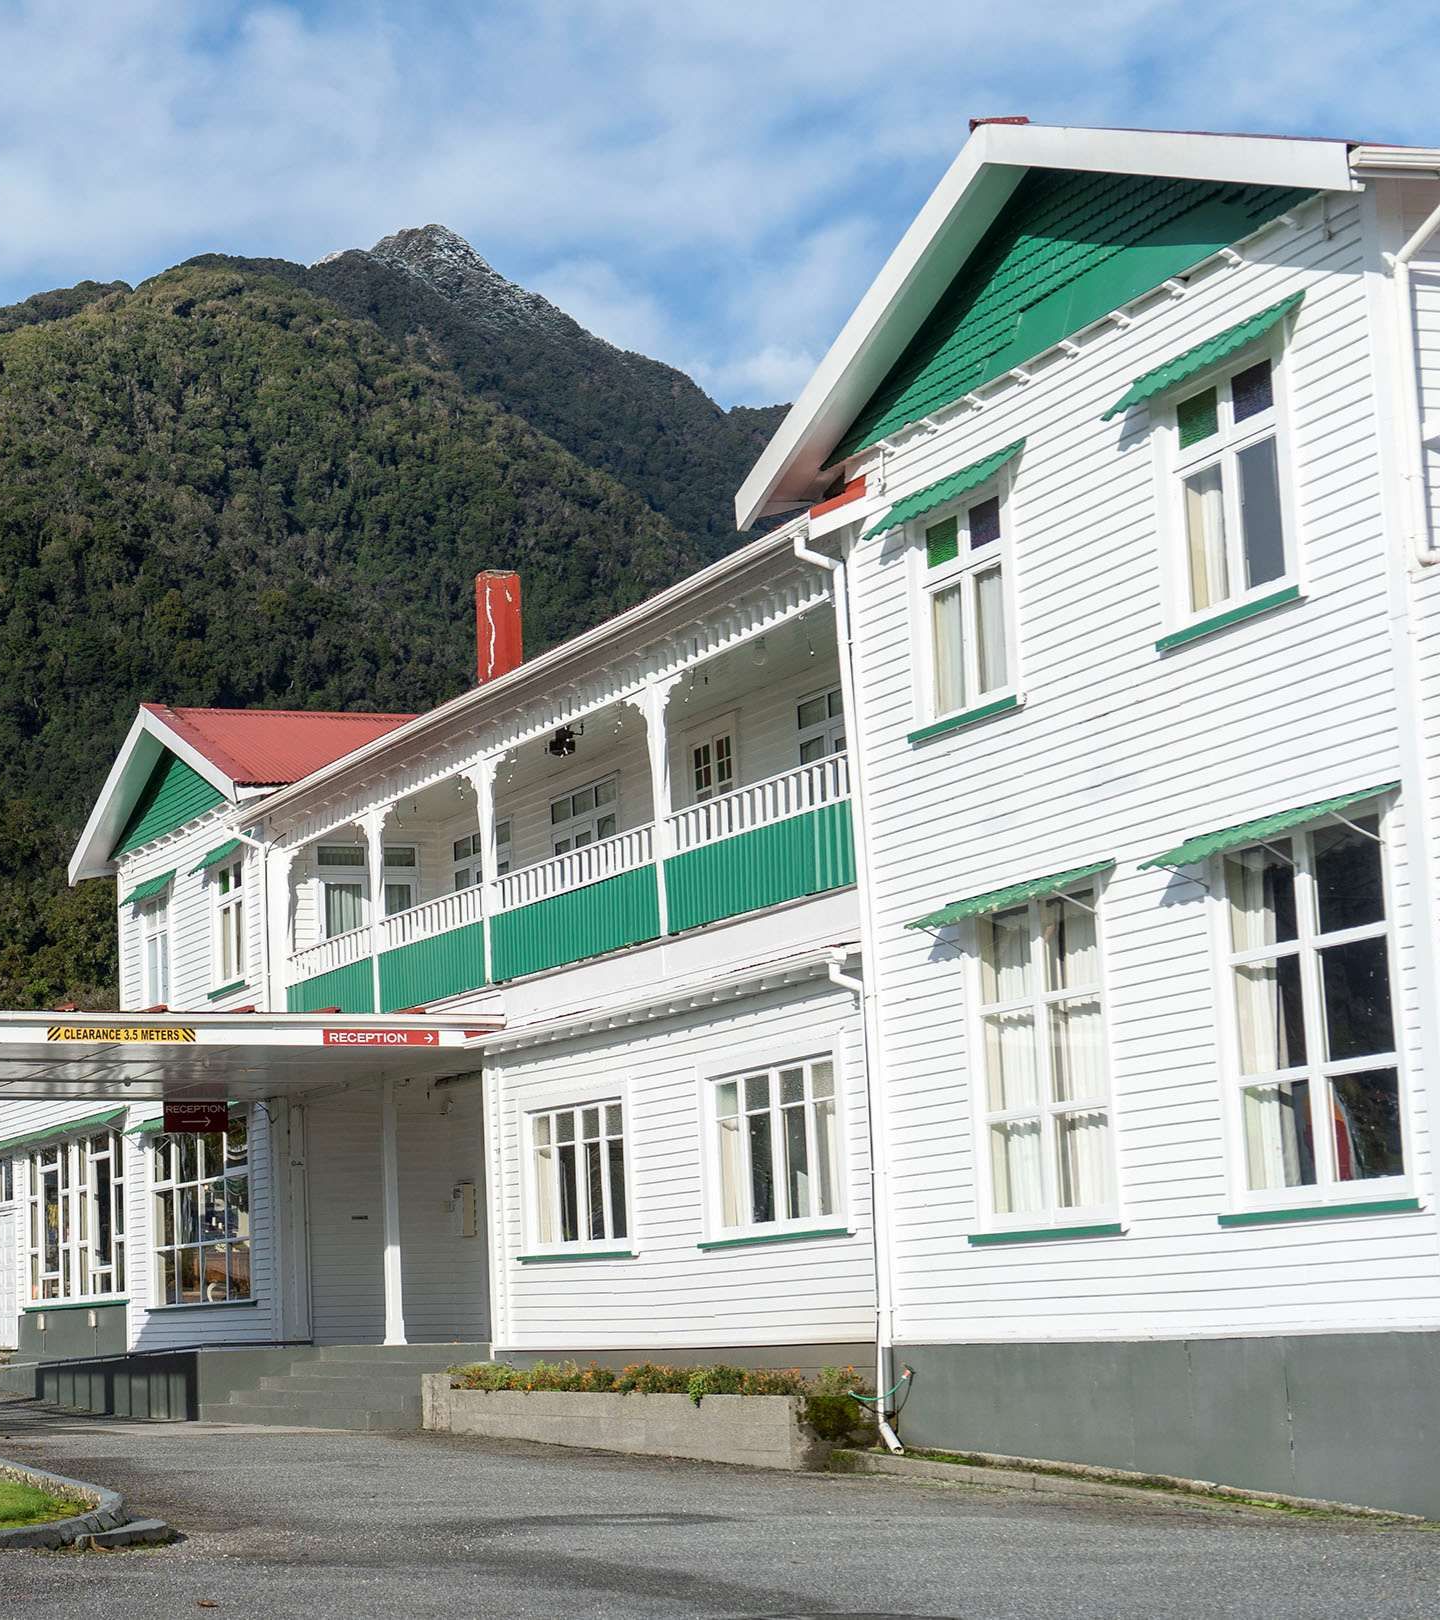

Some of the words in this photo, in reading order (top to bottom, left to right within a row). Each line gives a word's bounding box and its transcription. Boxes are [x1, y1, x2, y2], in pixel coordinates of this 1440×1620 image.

[64, 1028, 121, 1040] CLEARANCE
[124, 1029, 138, 1040] 3.5
[141, 1029, 179, 1041] METERS
[329, 1033, 408, 1043] RECEPTION
[165, 1104, 226, 1114] RECEPTION
